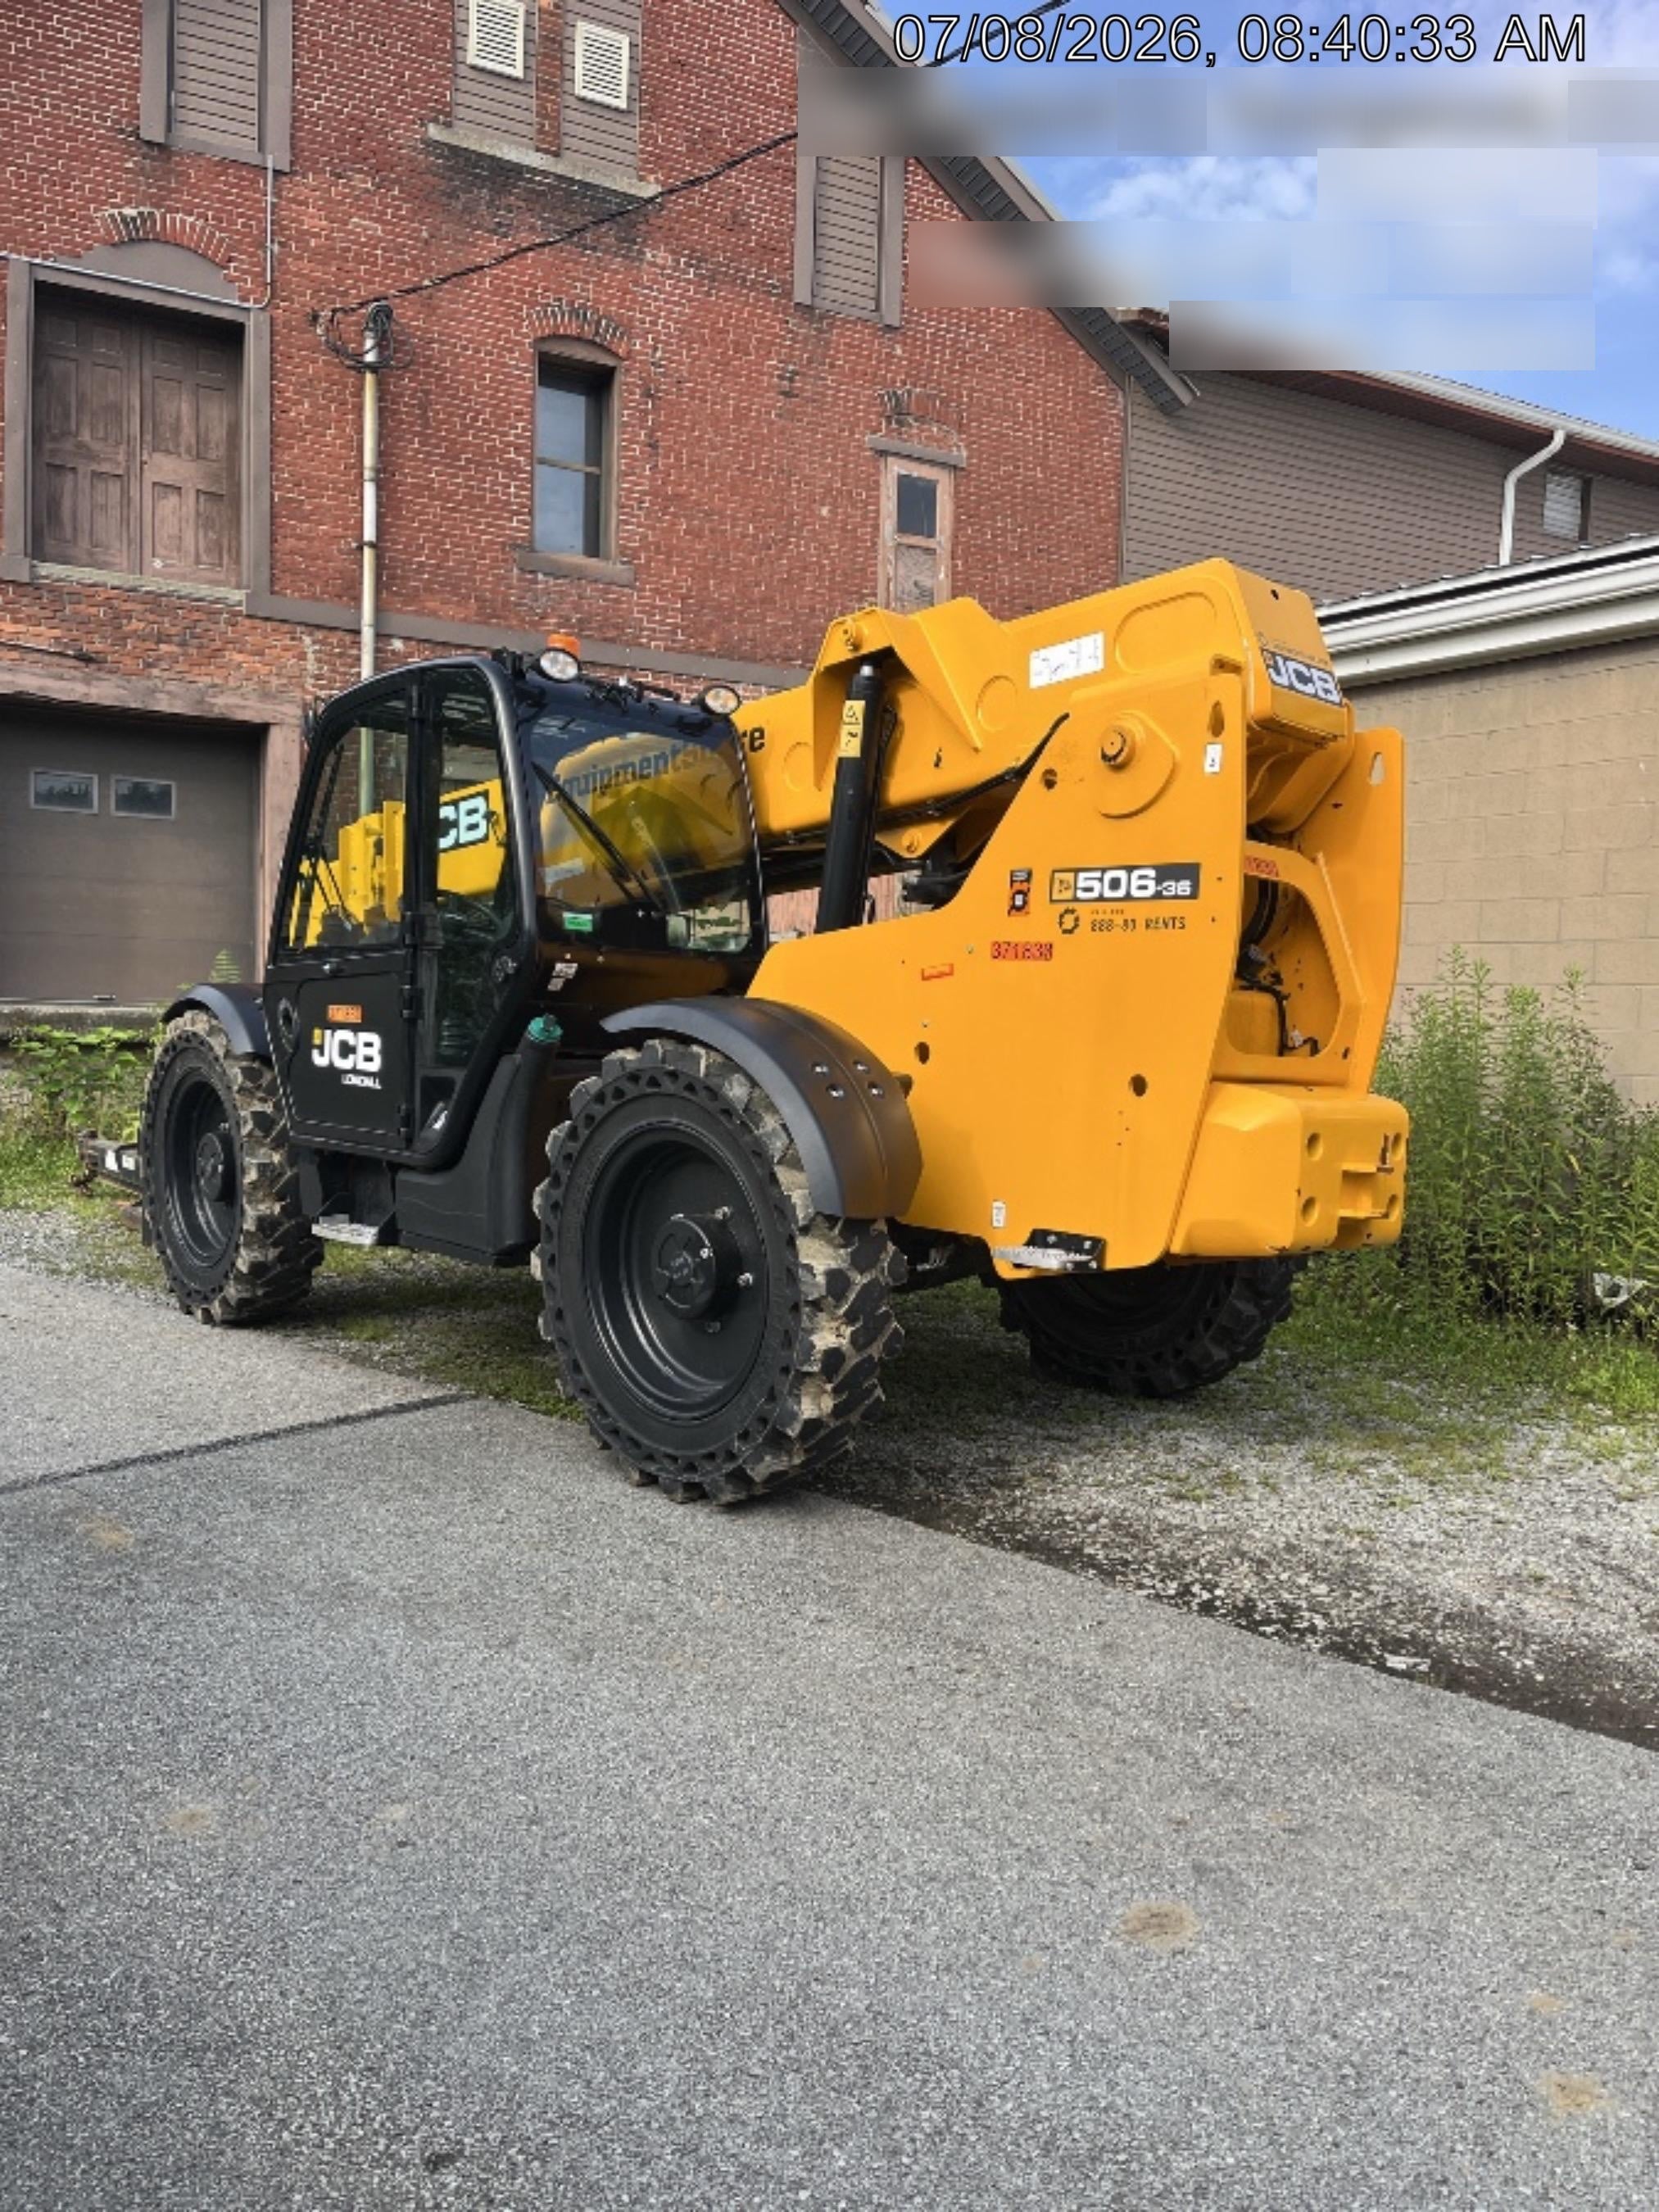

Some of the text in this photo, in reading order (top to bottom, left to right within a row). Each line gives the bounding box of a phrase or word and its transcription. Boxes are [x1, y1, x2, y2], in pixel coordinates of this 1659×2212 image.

[1268, 655, 1342, 705] JCB
[1075, 868, 1193, 900] 506-36
[1145, 916, 1186, 931] RENTS
[311, 1029, 382, 1072] JCB
